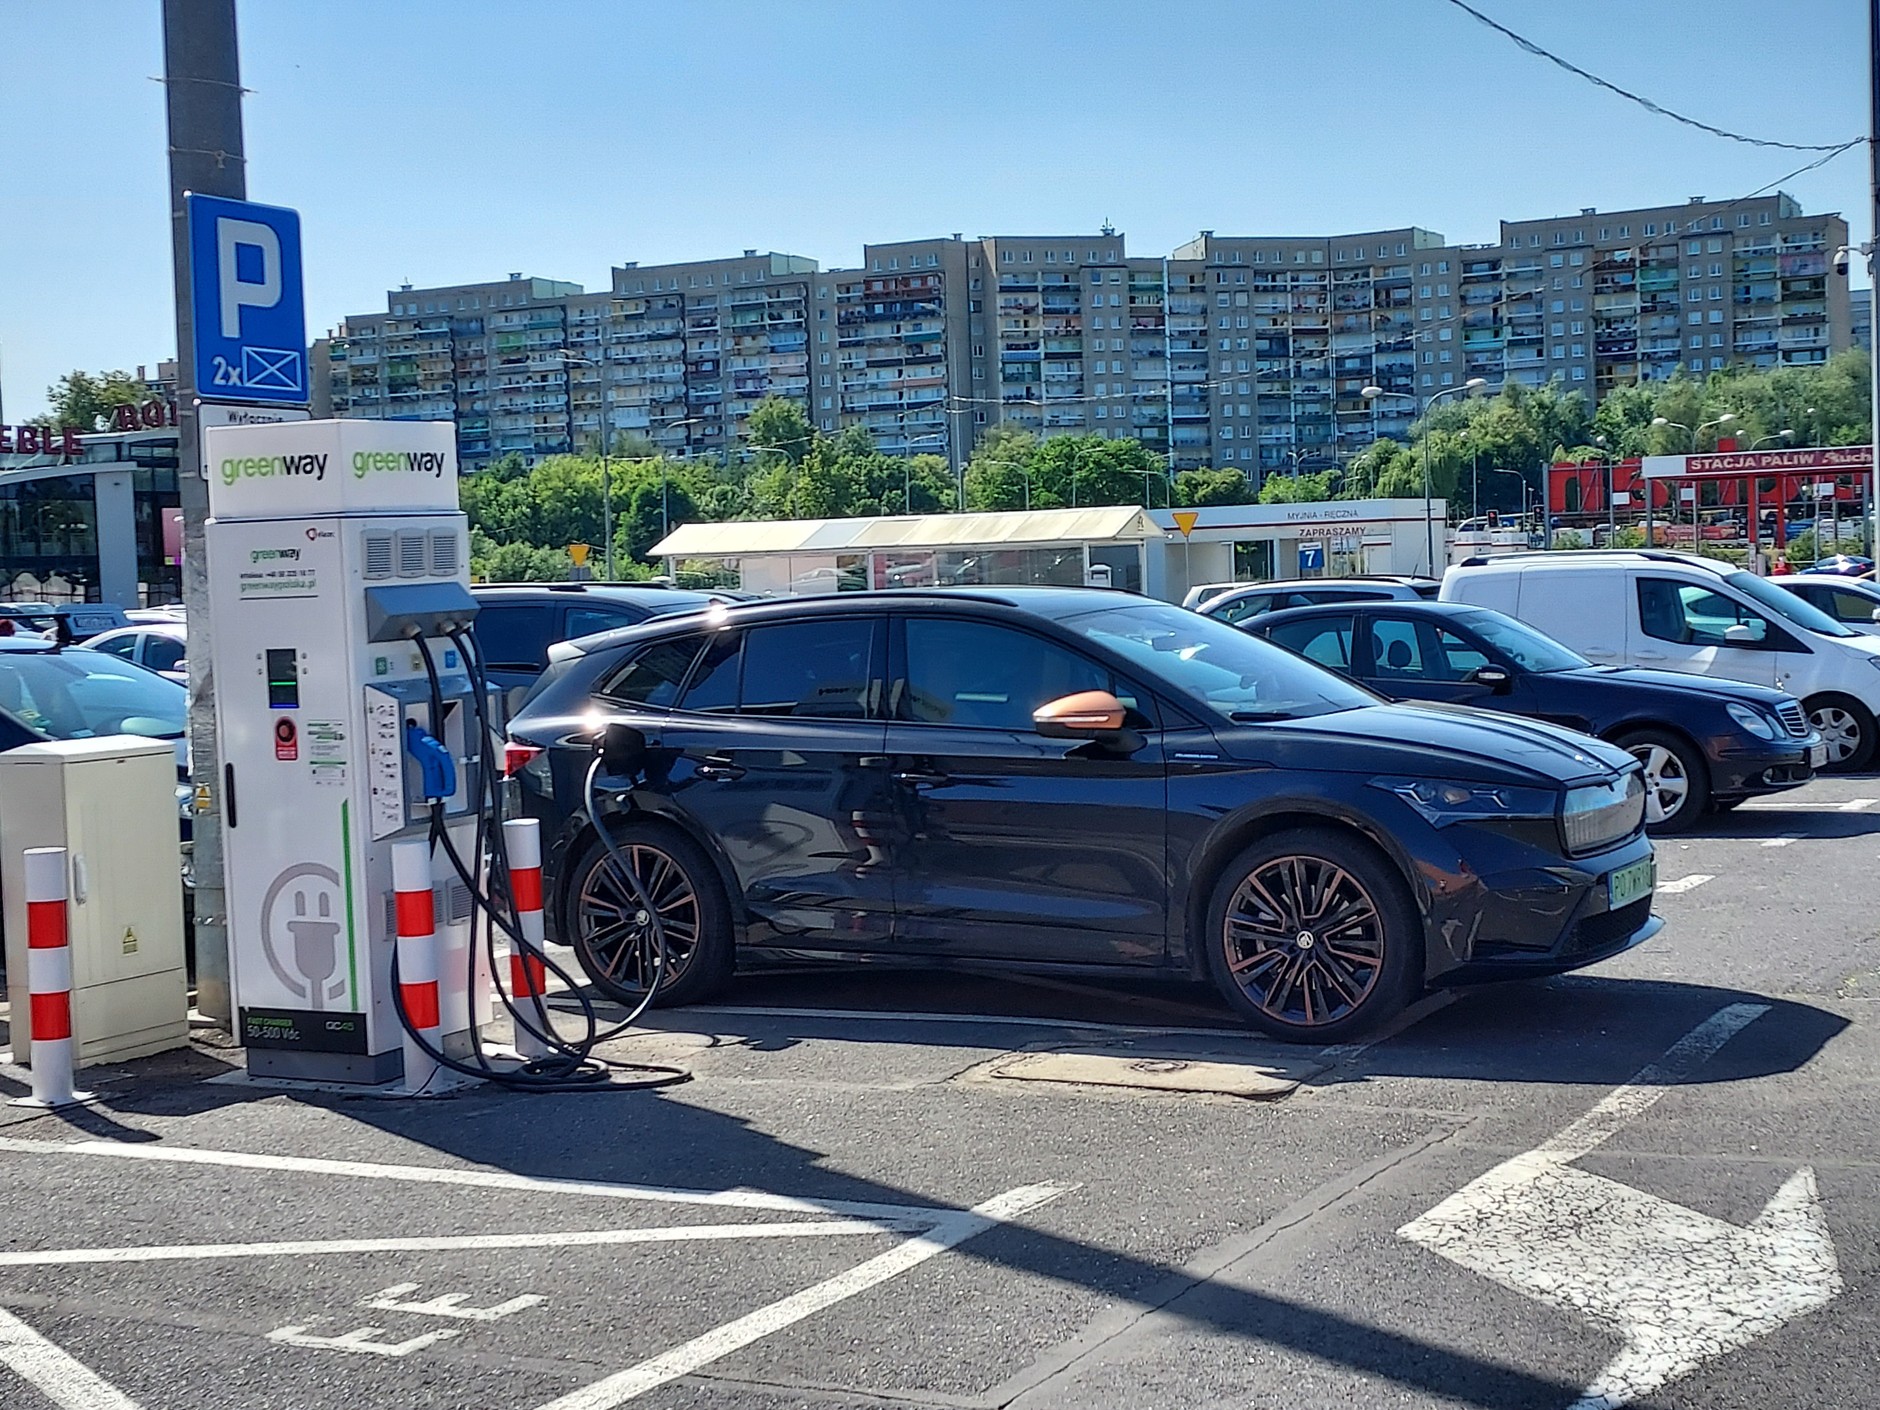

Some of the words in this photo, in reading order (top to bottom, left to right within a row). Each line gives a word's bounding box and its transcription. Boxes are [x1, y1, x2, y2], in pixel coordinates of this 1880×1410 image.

[217, 217, 282, 338] P
[213, 357, 243, 386] 2x
[0, 425, 84, 455] EBLE
[222, 453, 328, 485] greenway
[352, 450, 445, 480] greenway
[1691, 456, 1756, 470] STACJA
[1761, 454, 1815, 467] PALIW
[1287, 511, 1318, 520] MYJNIA
[1324, 510, 1359, 520] RĘCZNA
[1299, 527, 1366, 537] ZAPRASZAMY
[250, 548, 301, 563] greenway
[1305, 550, 1315, 567] 7
